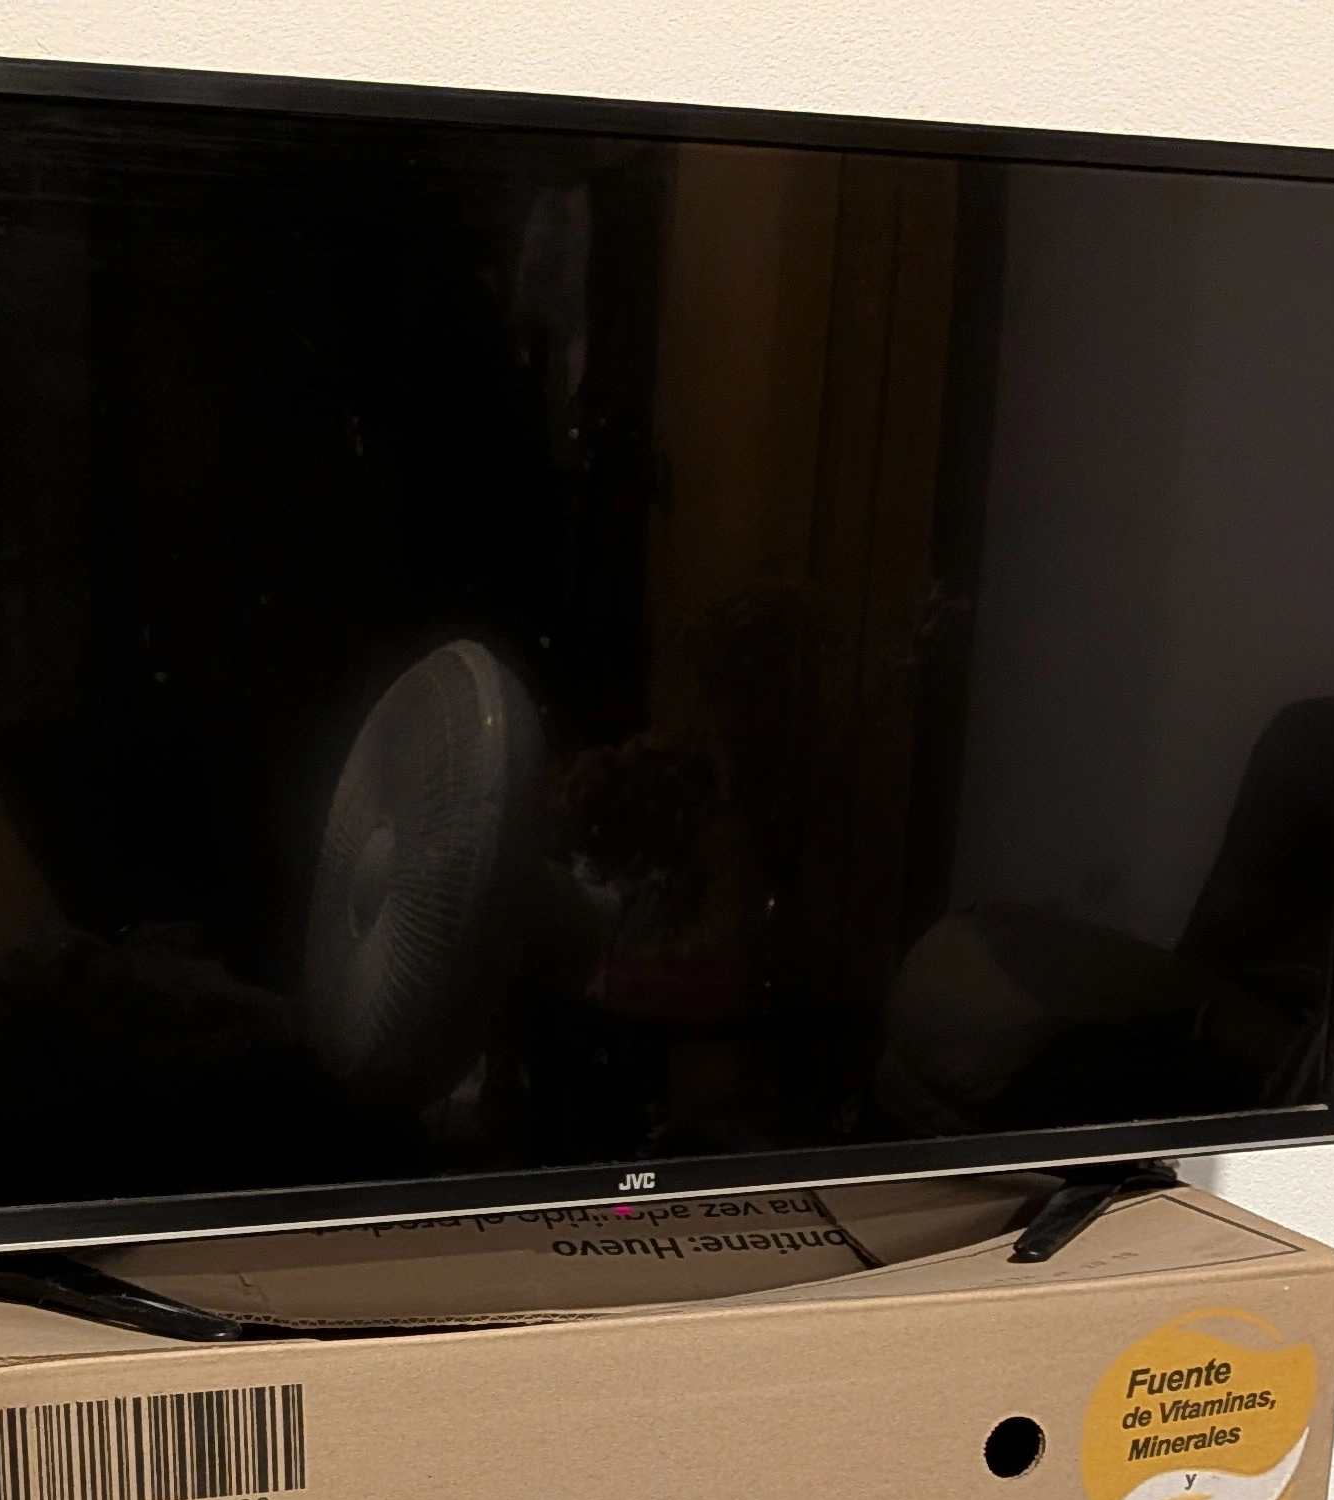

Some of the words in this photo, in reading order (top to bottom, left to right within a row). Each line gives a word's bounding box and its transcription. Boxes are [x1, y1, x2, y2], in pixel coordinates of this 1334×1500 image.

[618, 1172, 656, 1191] JVC
[698, 1201, 763, 1218] vez
[552, 1237, 685, 1260] Huevo
[686, 1228, 846, 1256] ontiene:
[1127, 1358, 1231, 1398] Fuente
[1122, 1406, 1152, 1429] de
[1160, 1388, 1276, 1424] Vitaminas,
[1128, 1425, 1241, 1462] Minerales
[1184, 1474, 1197, 1490] y
